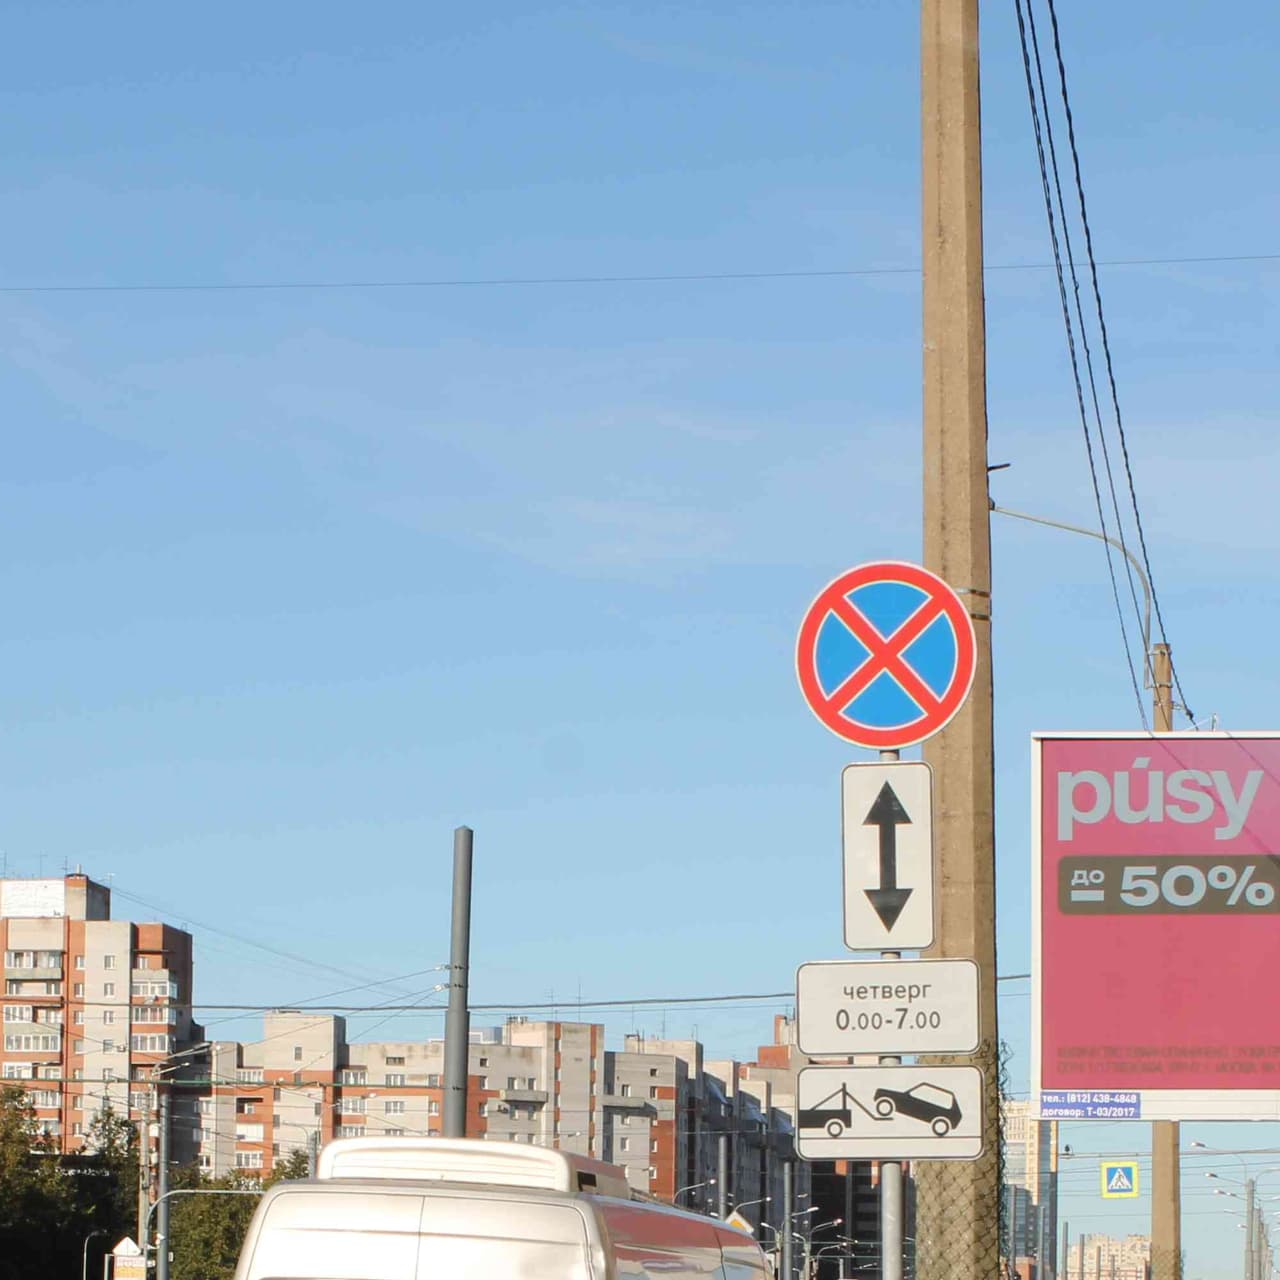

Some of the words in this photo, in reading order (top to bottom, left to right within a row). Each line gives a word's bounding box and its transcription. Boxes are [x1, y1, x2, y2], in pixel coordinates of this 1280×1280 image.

[1057, 757, 1265, 841] púsy
[1071, 869, 1105, 886] до
[843, 983, 932, 1003] четверг
[835, 1008, 941, 1030] 0.00-7.00
[1042, 1108, 1085, 1118] договор:
